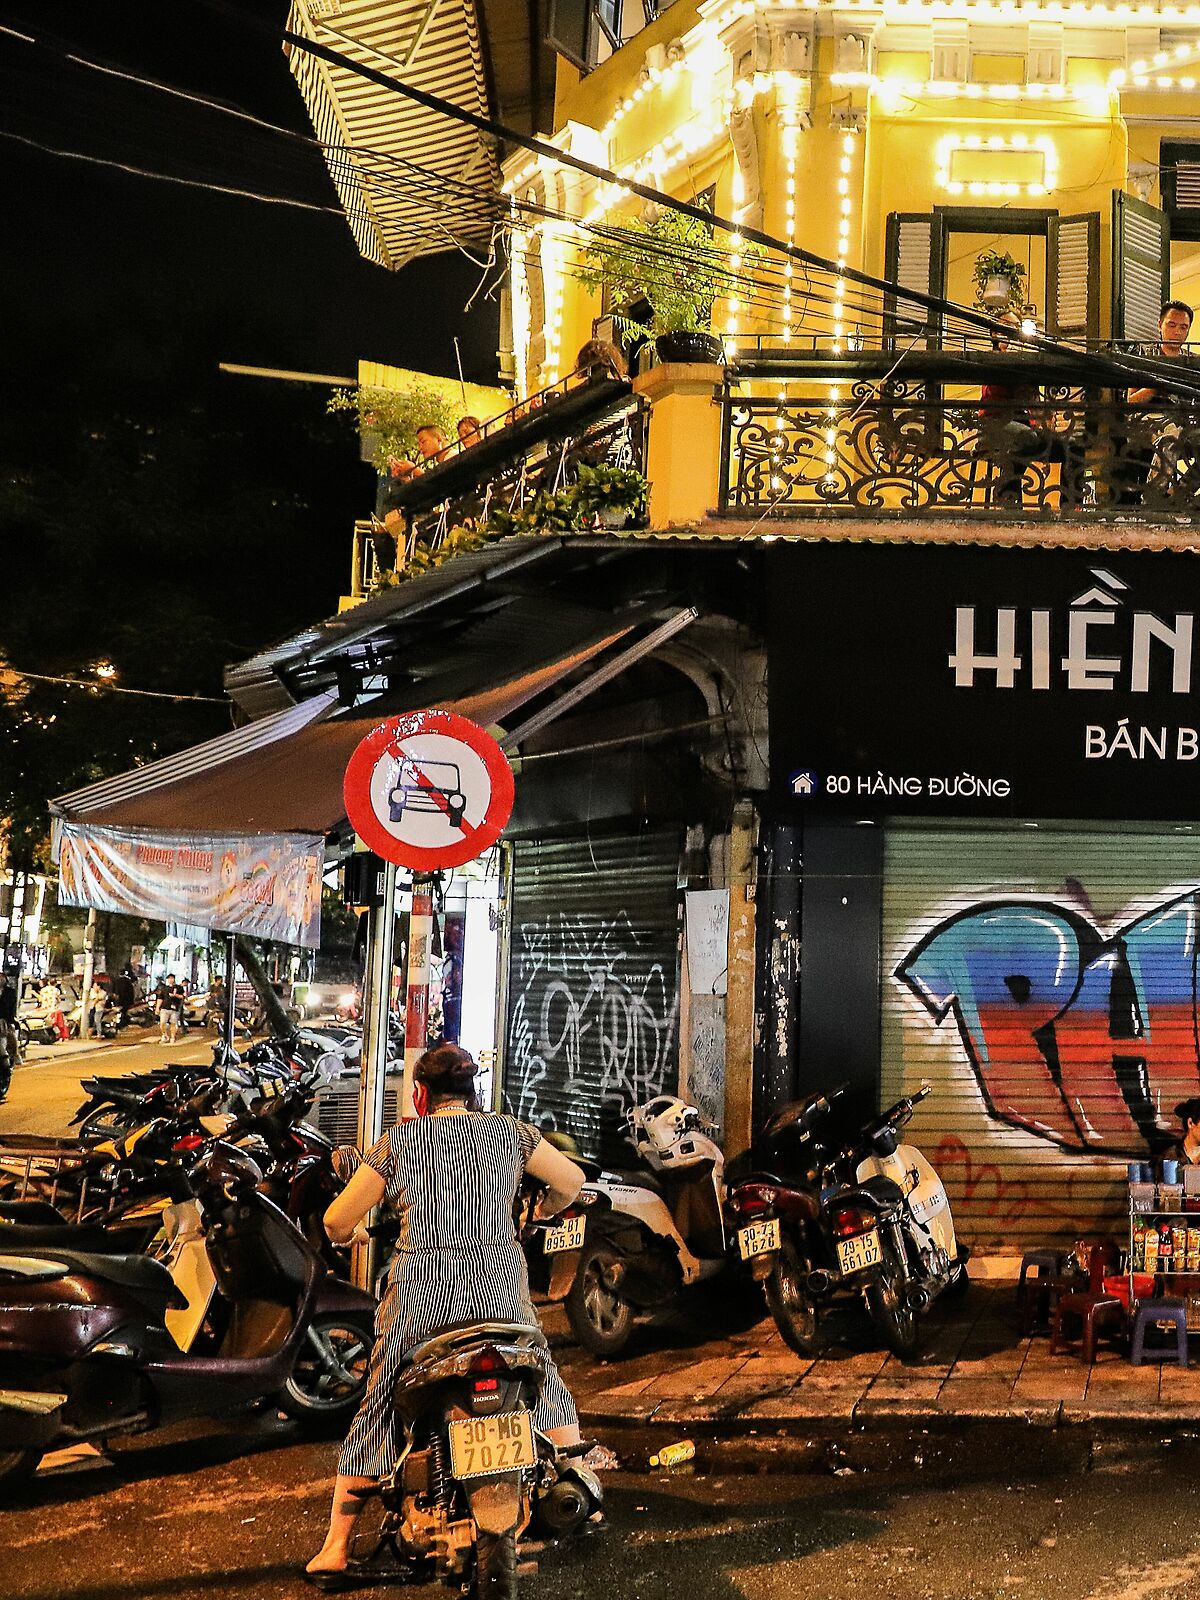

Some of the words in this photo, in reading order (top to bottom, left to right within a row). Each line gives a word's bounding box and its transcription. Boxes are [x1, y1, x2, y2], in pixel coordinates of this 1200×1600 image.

[948, 567, 1195, 693] HIỀN
[1084, 717, 1167, 760] BÁN
[825, 775, 851, 795] 80
[857, 770, 923, 796] HÀNG
[927, 771, 1011, 798] ĐƯỜNG
[546, 1232, 582, 1251] 895.30
[842, 1233, 873, 1257] 29-Y5
[842, 1248, 878, 1272] 561.07
[473, 1393, 500, 1403] HONDA
[462, 1415, 523, 1445] 30-M6
[464, 1440, 525, 1472] 7022
